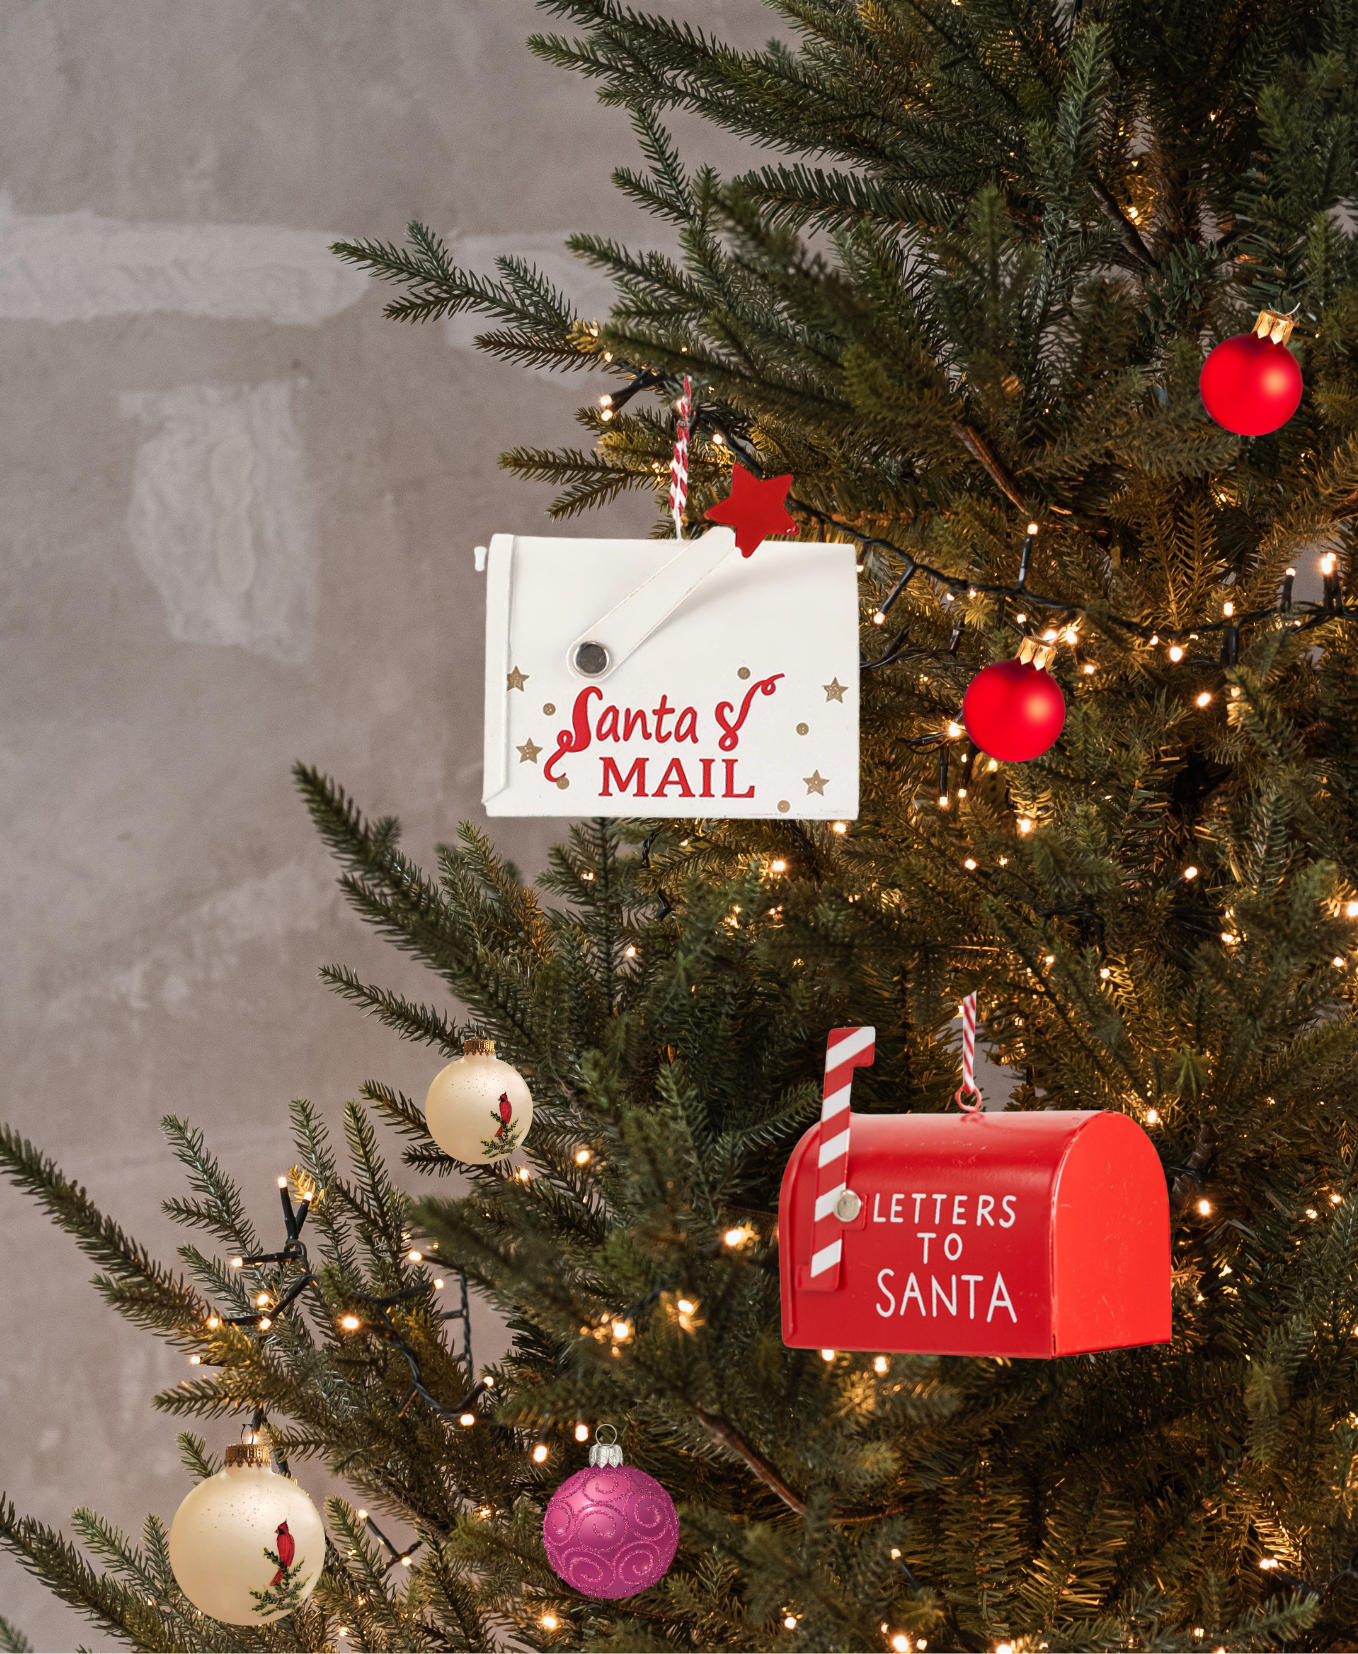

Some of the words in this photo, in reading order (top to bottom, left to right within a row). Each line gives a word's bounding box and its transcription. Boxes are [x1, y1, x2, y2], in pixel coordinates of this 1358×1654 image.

[597, 756, 756, 799] MAIL
[872, 1192, 1018, 1229] LETTERS
[915, 1232, 964, 1265] TO
[875, 1268, 1018, 1324] SANTA
